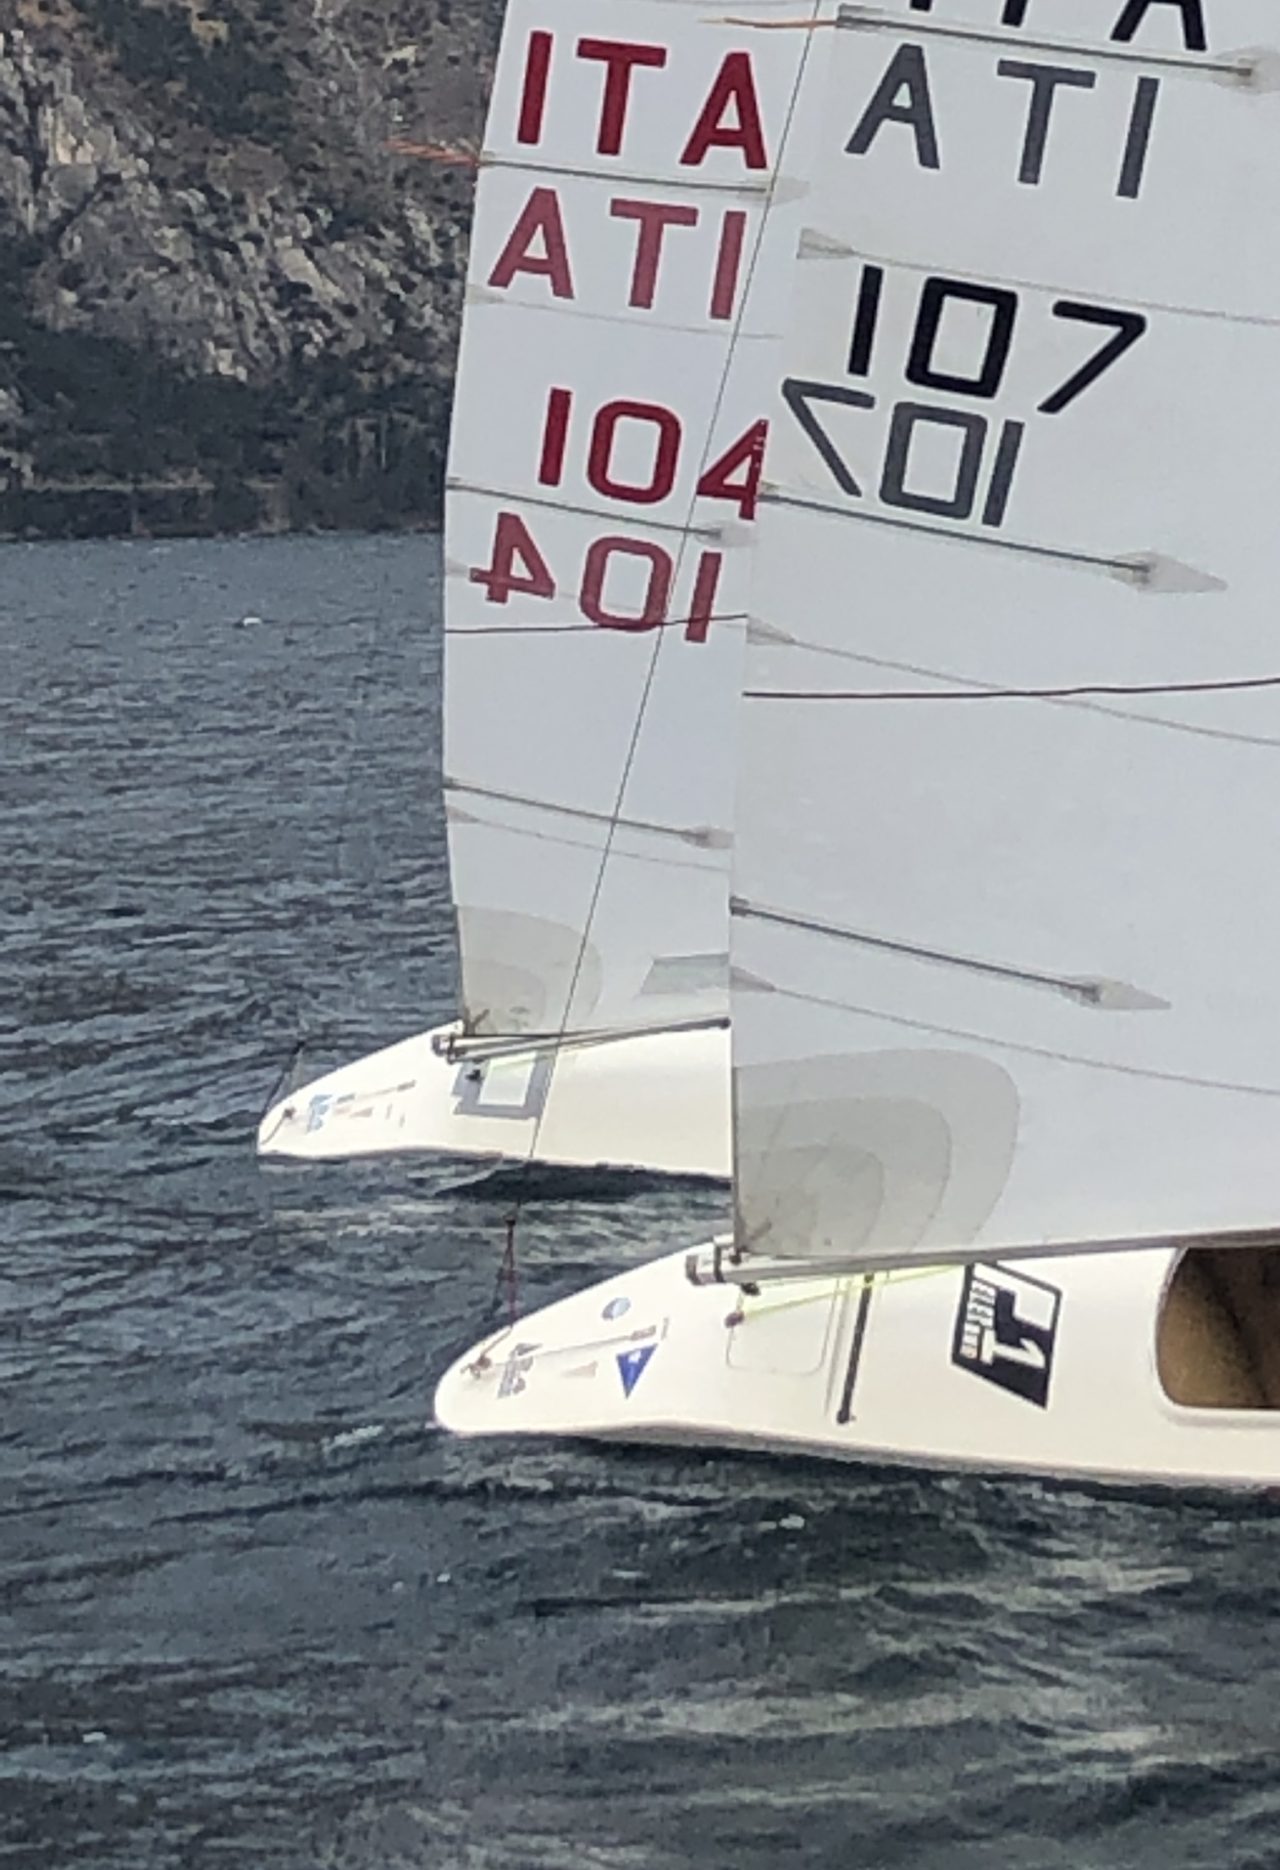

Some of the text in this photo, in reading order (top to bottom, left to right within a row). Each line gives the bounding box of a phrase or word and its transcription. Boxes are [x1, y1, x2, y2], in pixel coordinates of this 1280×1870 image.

[516, 30, 768, 170] ITA
[847, 264, 1146, 414] 107
[538, 387, 769, 521] 104
